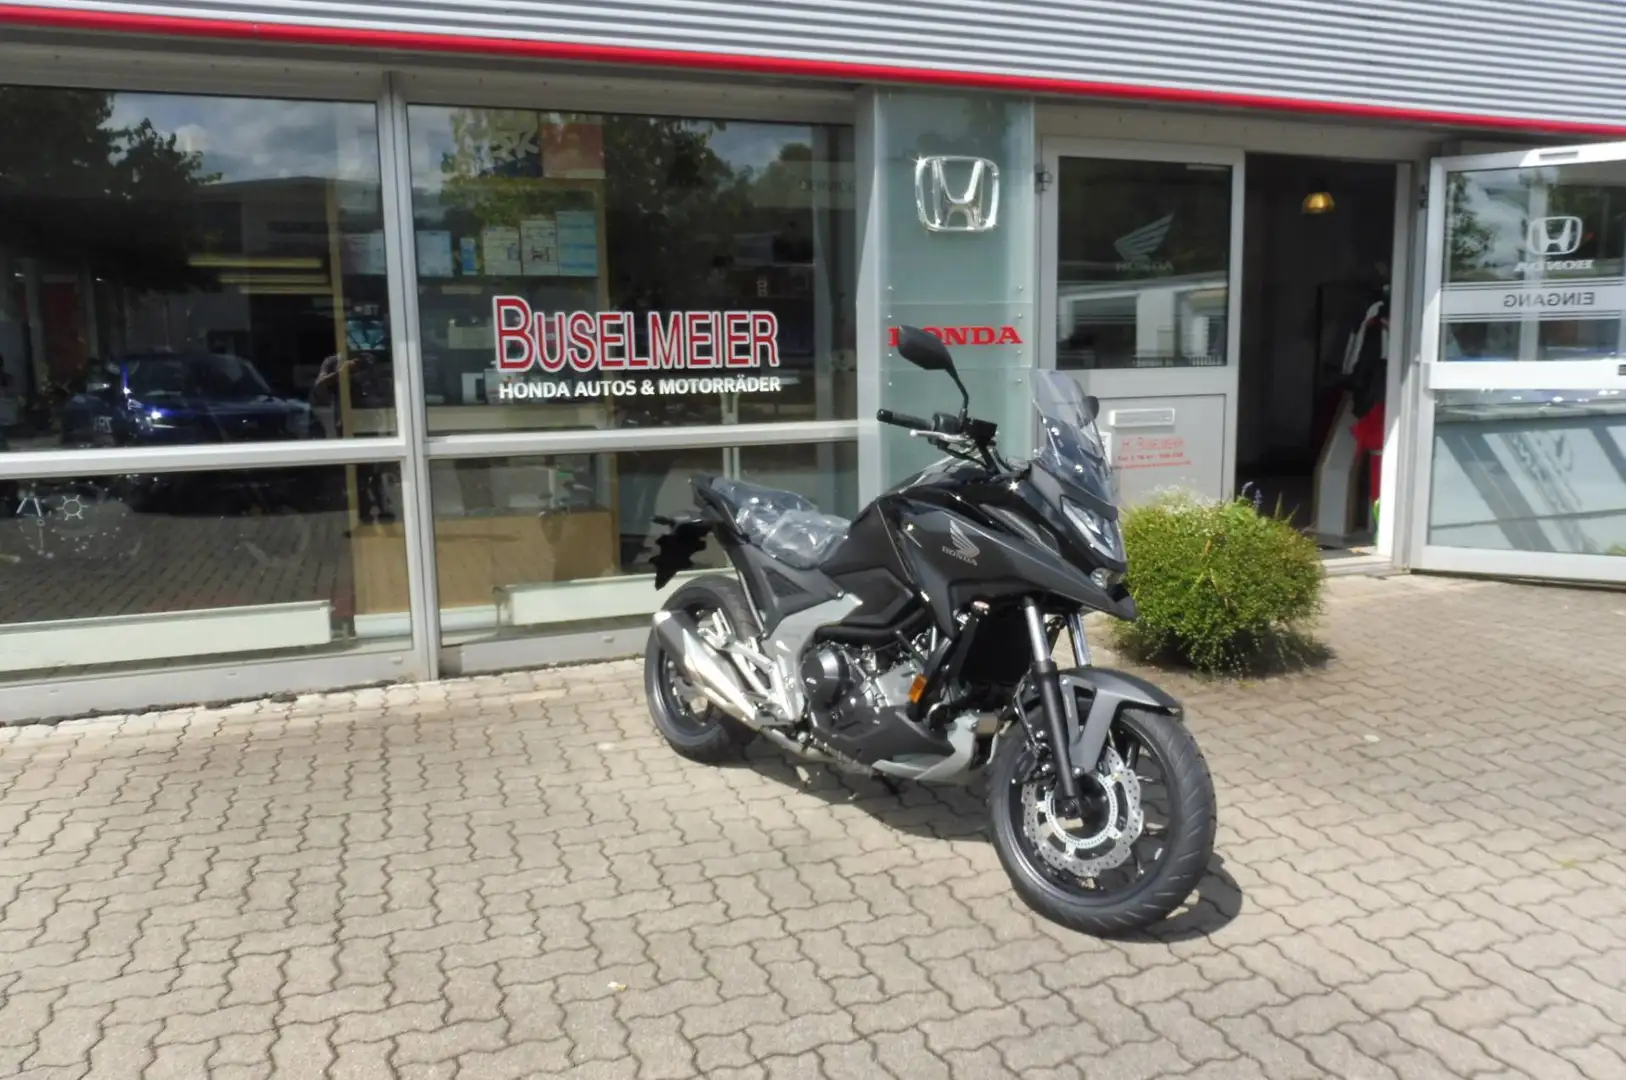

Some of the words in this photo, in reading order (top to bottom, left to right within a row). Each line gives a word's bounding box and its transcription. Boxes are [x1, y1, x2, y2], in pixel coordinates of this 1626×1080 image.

[492, 295, 780, 373] BUSELMEIER
[499, 380, 571, 399] HONDA
[573, 379, 637, 397] AUTOS
[640, 379, 655, 396] &
[659, 374, 782, 395] MOTORRÄDER
[942, 546, 978, 566] HONDA
